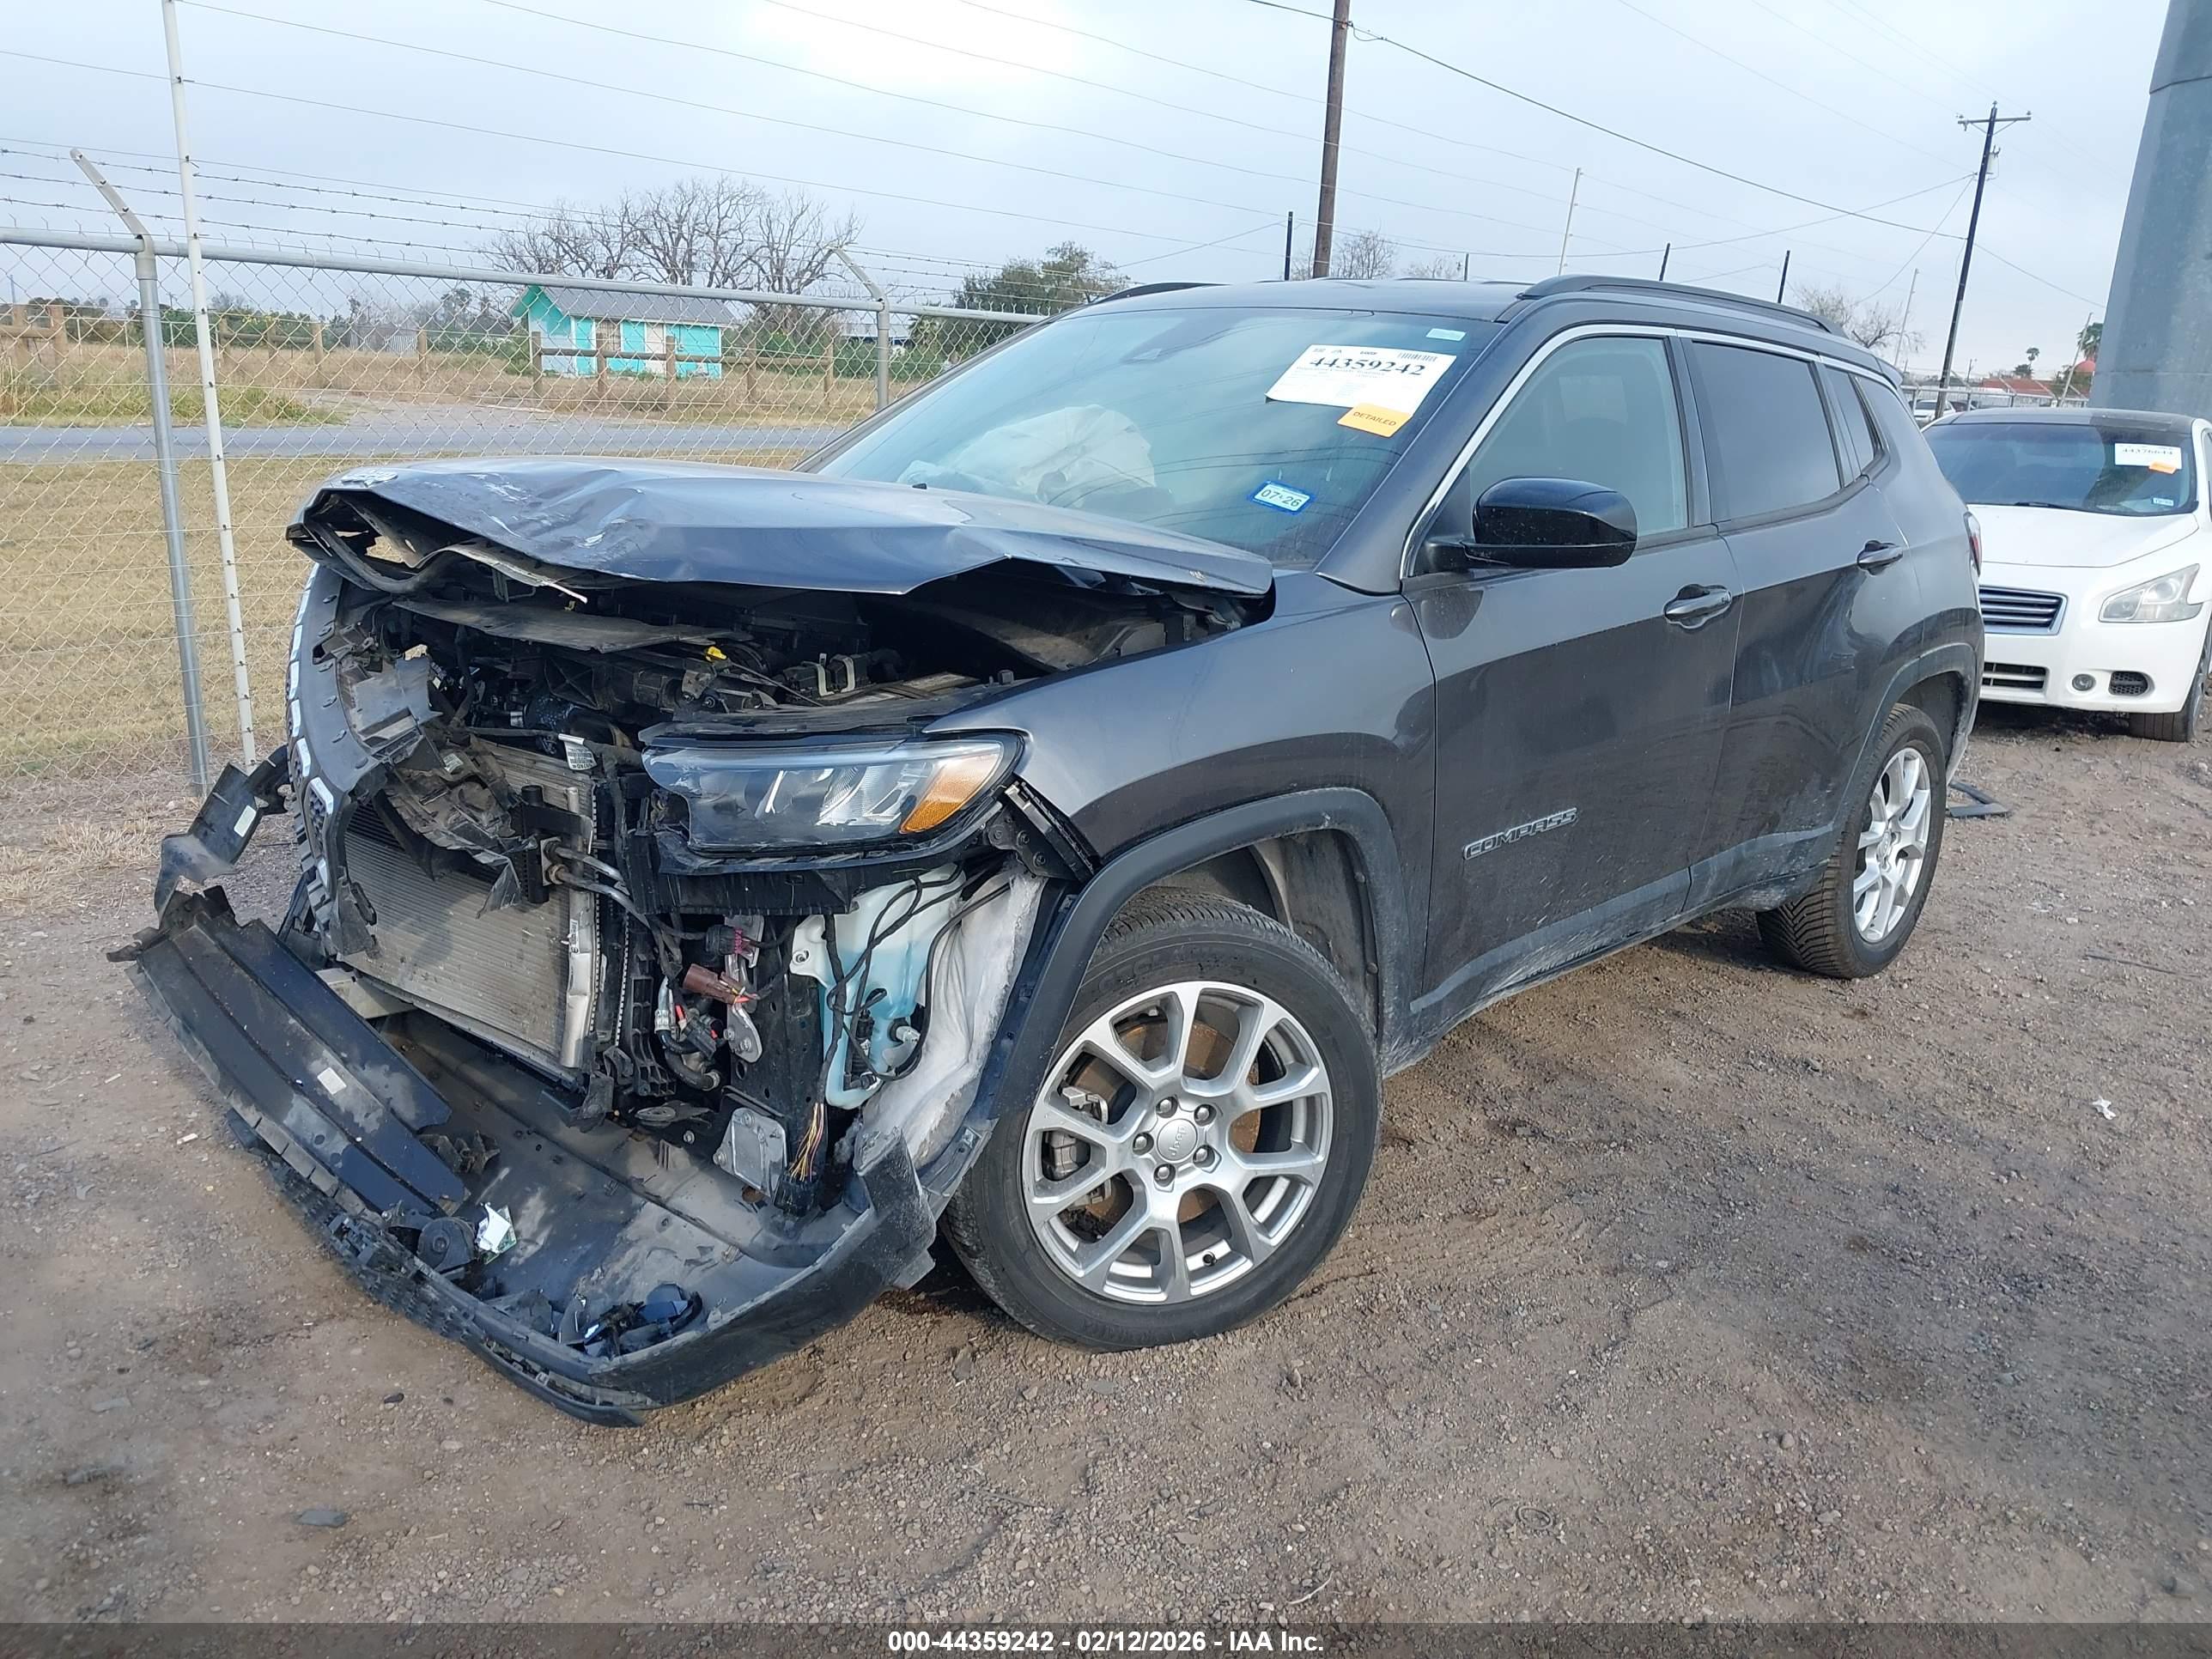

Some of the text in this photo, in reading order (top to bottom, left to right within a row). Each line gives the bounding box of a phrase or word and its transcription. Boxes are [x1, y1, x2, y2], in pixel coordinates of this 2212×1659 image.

[1310, 356, 1426, 376] 44359242
[1352, 410, 1397, 428] DETAILED
[1463, 807, 1577, 860] COMPASS
[1169, 1126, 1187, 1156] Jeep
